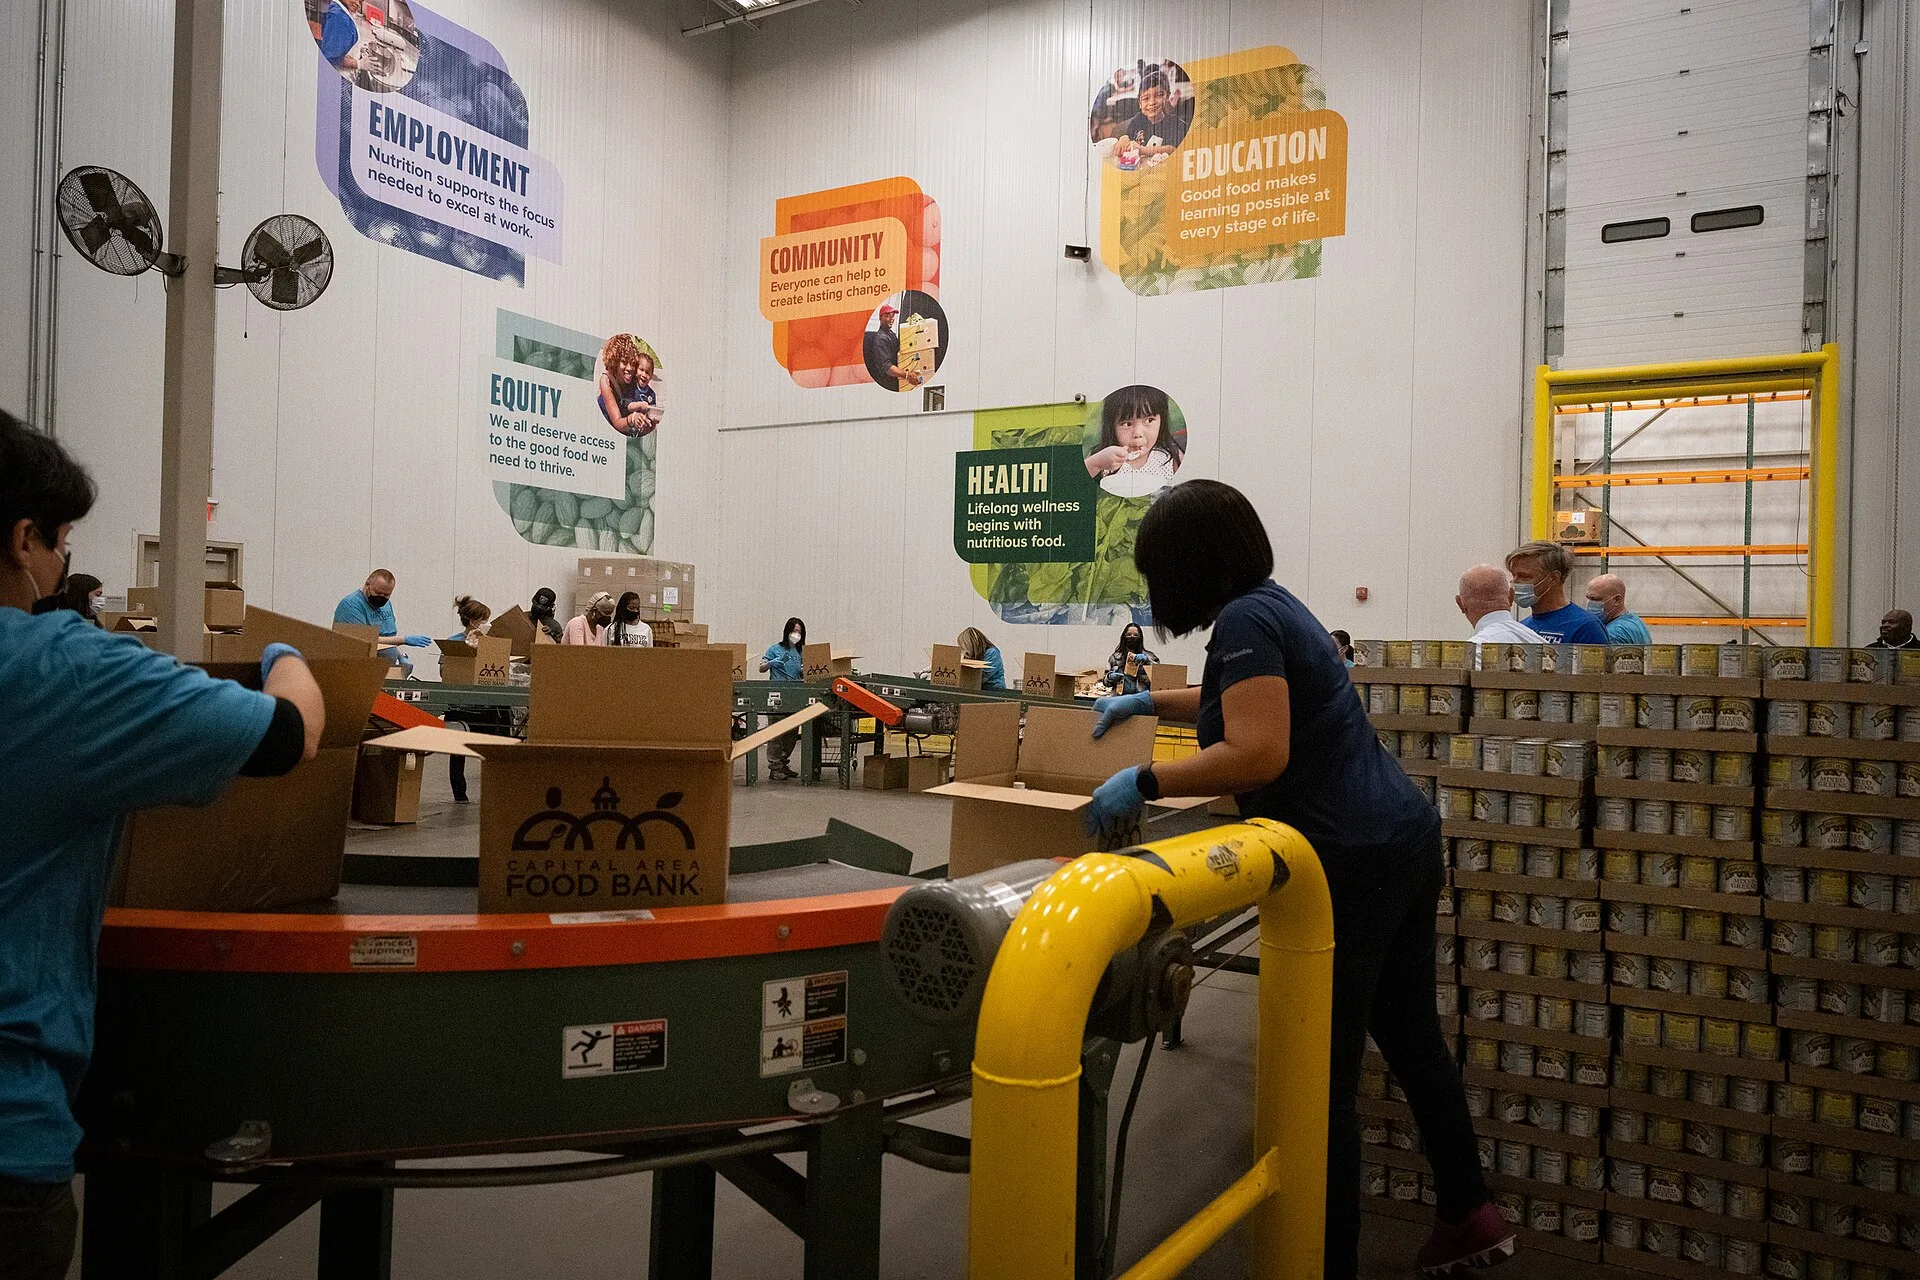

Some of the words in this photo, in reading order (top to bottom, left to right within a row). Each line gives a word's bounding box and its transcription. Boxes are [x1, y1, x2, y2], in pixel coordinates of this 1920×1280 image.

[368, 100, 530, 197] EMPLOYMENT
[1182, 126, 1326, 182] EDUCATION
[368, 144, 432, 182] Nutrition
[436, 174, 496, 206] supports
[498, 195, 518, 215] the
[522, 206, 554, 229] focus
[1181, 187, 1220, 203] Good
[1226, 179, 1260, 196] food
[1266, 173, 1316, 190] makes
[368, 168, 423, 196] needed
[428, 188, 442, 204] to
[446, 198, 480, 220] excel
[484, 211, 496, 226] at
[500, 217, 534, 238] work.
[1181, 204, 1240, 222] learning
[1246, 194, 1310, 214] possible
[1314, 188, 1330, 202] at
[1180, 224, 1221, 240] every
[1225, 218, 1267, 234] stage
[1272, 212, 1289, 227] of
[1292, 210, 1320, 224] life.
[770, 232, 884, 274] COMMUNITY
[771, 276, 820, 293] Everyone
[824, 274, 842, 285] can
[846, 268, 870, 282] help
[874, 266, 886, 277] to
[770, 295, 804, 308] create
[806, 290, 842, 302] lasting
[846, 283, 890, 297] change.
[490, 374, 562, 418] EQUITY
[490, 413, 510, 428] We
[514, 419, 528, 433] all
[531, 422, 576, 442] deserve
[580, 434, 616, 450] access
[490, 434, 502, 446] to
[506, 436, 526, 450] the
[530, 440, 560, 456] good
[563, 446, 588, 462] food
[592, 454, 608, 466] we
[490, 452, 520, 468] need
[524, 458, 536, 470] to
[540, 460, 575, 477] thrive.
[968, 462, 1048, 496] HEALTH
[968, 502, 1018, 516] Lifelong
[1022, 500, 1080, 513] wellness
[968, 520, 1010, 534] begins
[1014, 518, 1042, 530] with
[967, 536, 1028, 548] nutritious
[1032, 535, 1066, 548] food.
[508, 860, 618, 872] CAPITAL
[636, 860, 700, 872] AREA
[506, 874, 599, 896] FOOD
[611, 874, 700, 896] BANK
[628, 1022, 663, 1034] DANGER
